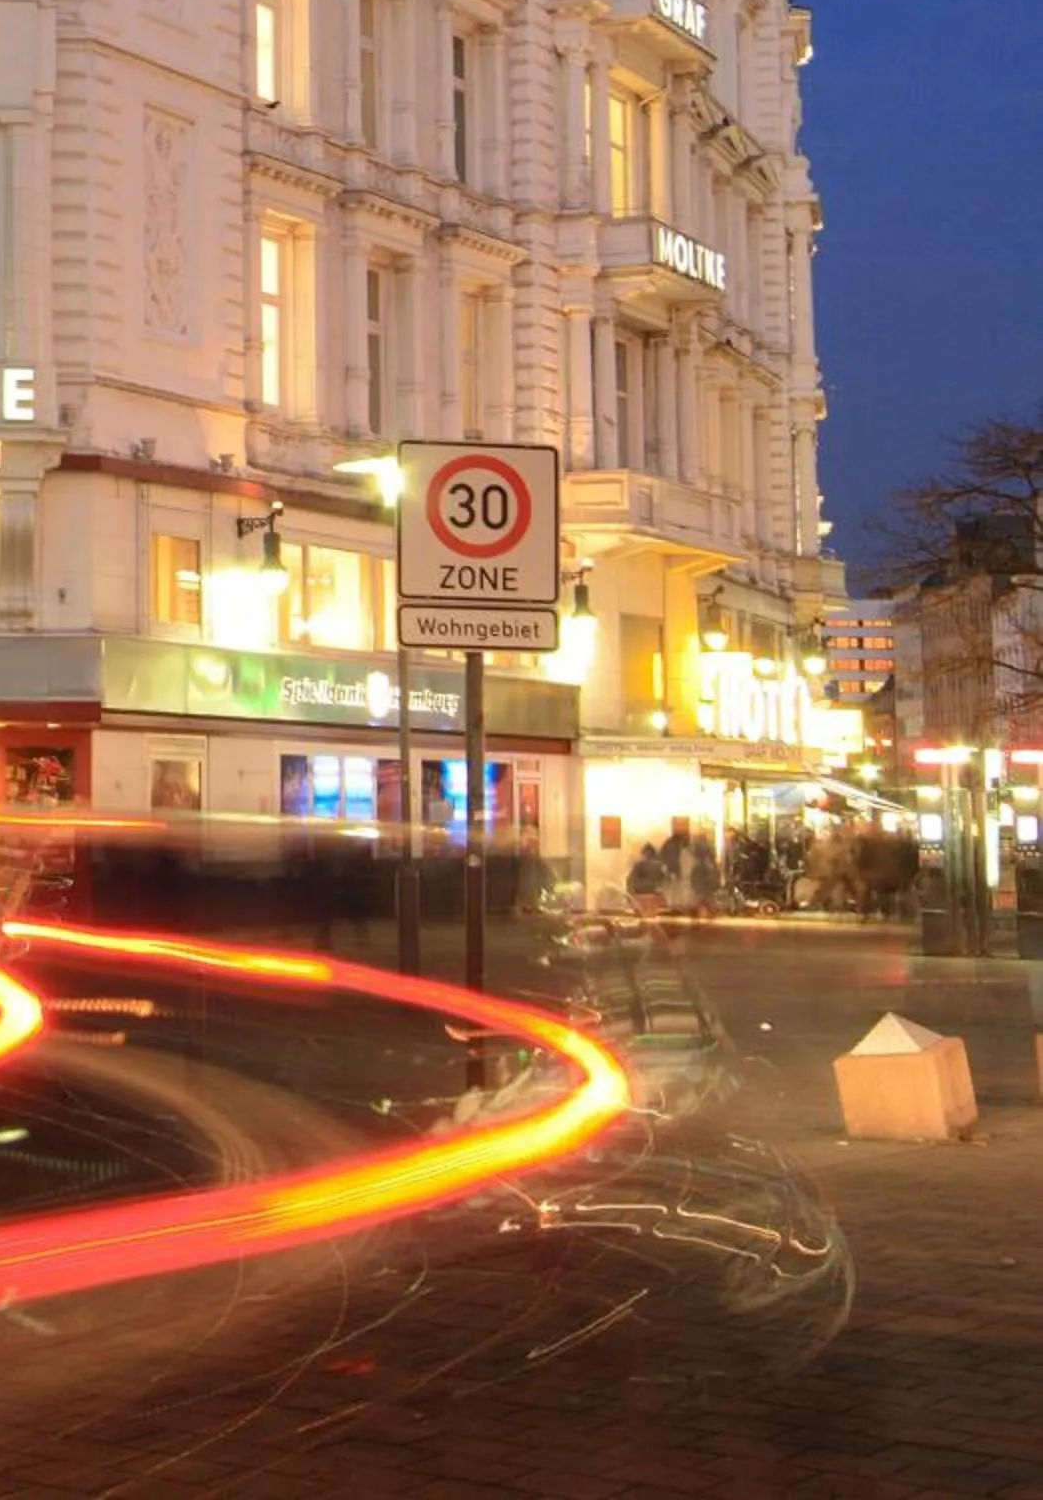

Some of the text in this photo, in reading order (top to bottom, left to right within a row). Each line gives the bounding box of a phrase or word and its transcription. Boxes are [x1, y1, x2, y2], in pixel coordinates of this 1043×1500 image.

[658, 227, 726, 290] MOLTKE
[448, 483, 508, 530] 30
[439, 565, 519, 592] ZONE
[416, 615, 541, 641] Wohngebiet
